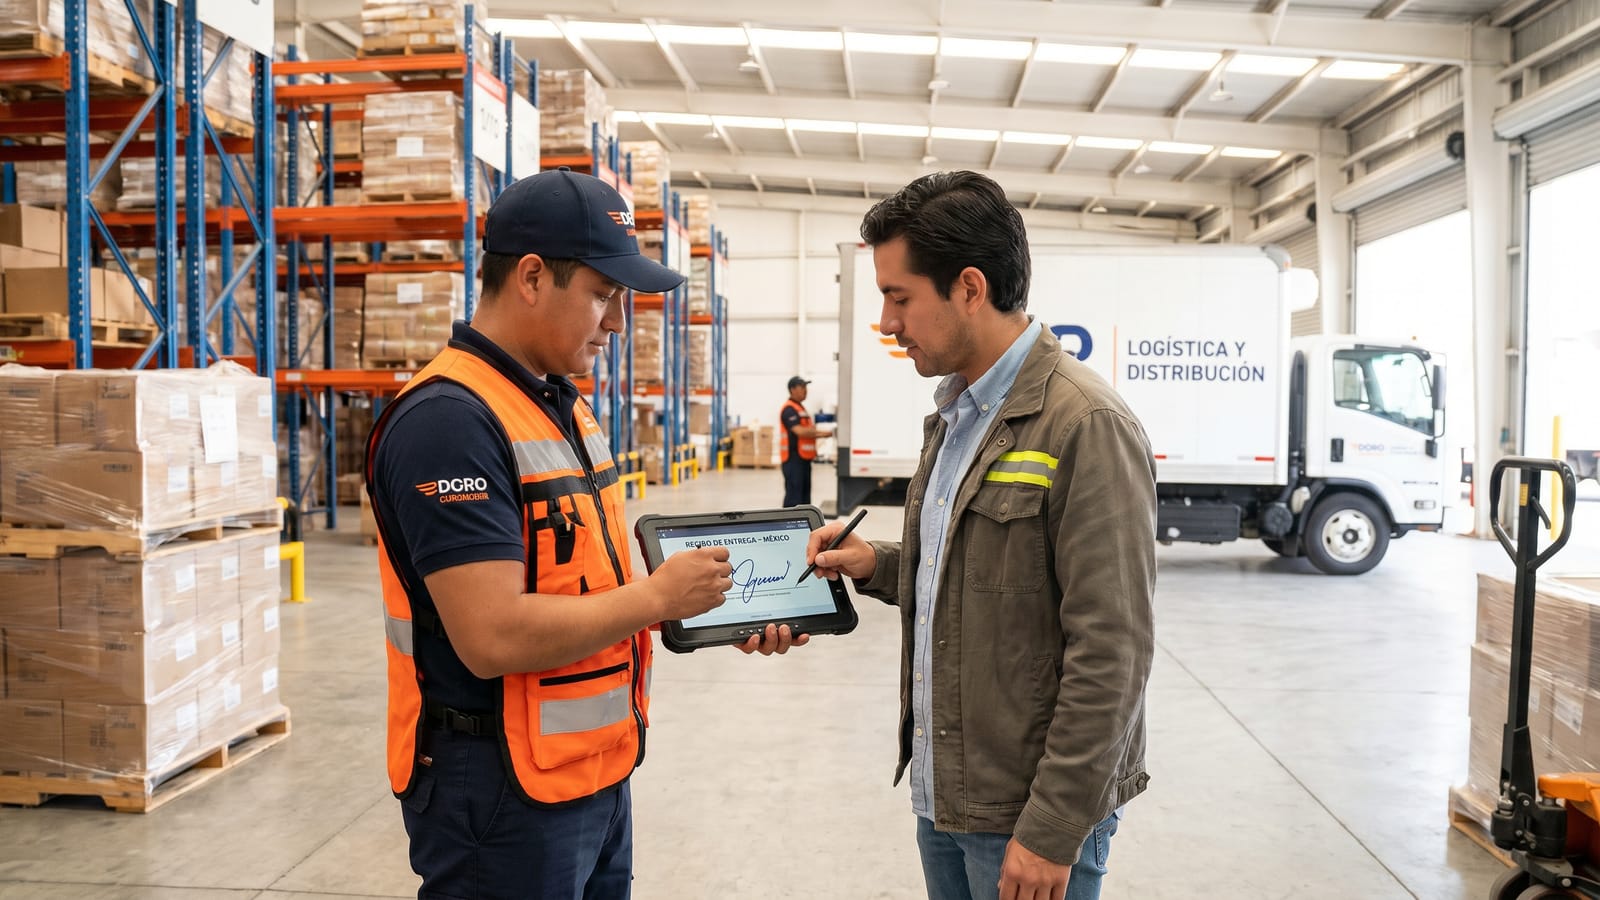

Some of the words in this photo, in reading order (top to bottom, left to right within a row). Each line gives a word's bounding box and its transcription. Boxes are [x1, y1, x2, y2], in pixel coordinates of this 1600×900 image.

[1128, 336, 1228, 357] LOGÍSTICA
[1234, 341, 1246, 357] Y
[1127, 361, 1265, 381] DISTRIBUCIÓN
[685, 540, 712, 548] RECIBO
[724, 537, 757, 546] ENTREGA
[763, 534, 790, 543] MÉXICO
